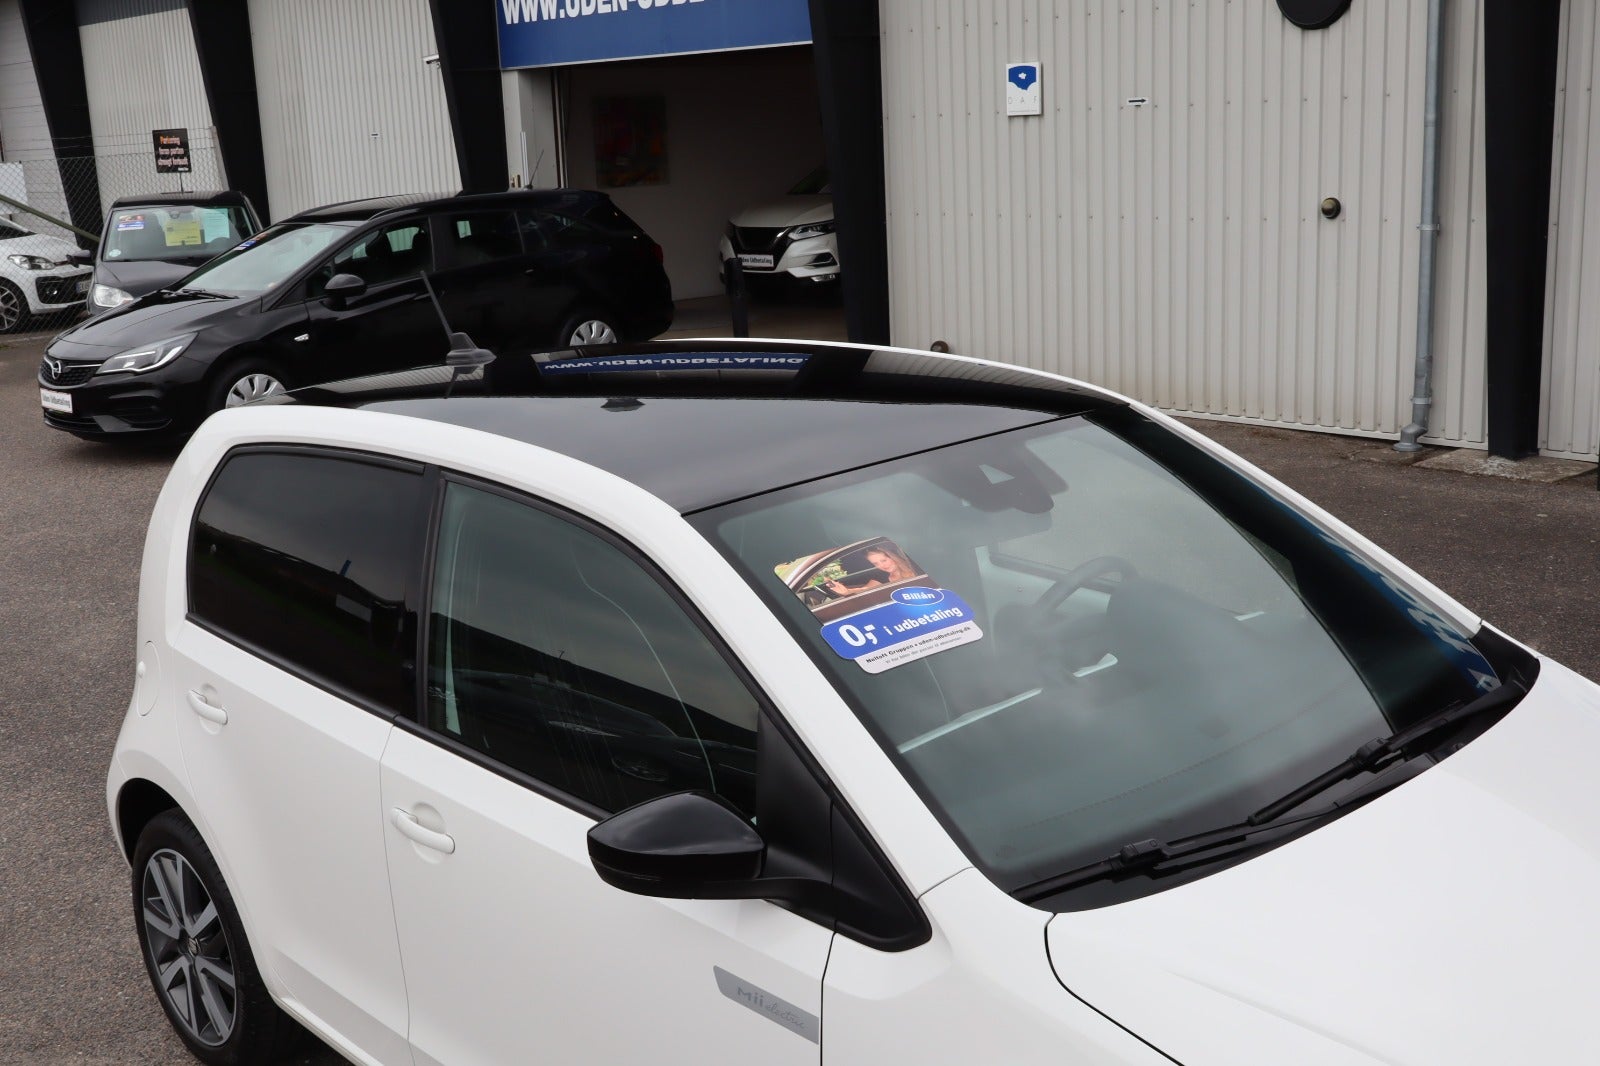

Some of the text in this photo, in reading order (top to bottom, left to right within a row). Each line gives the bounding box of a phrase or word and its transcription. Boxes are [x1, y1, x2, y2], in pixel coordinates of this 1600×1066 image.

[901, 592, 936, 601] Billån
[883, 626, 893, 636] i
[894, 608, 963, 632] udbetaling
[889, 644, 914, 656] Gruppen
[737, 986, 764, 1007] Mii
